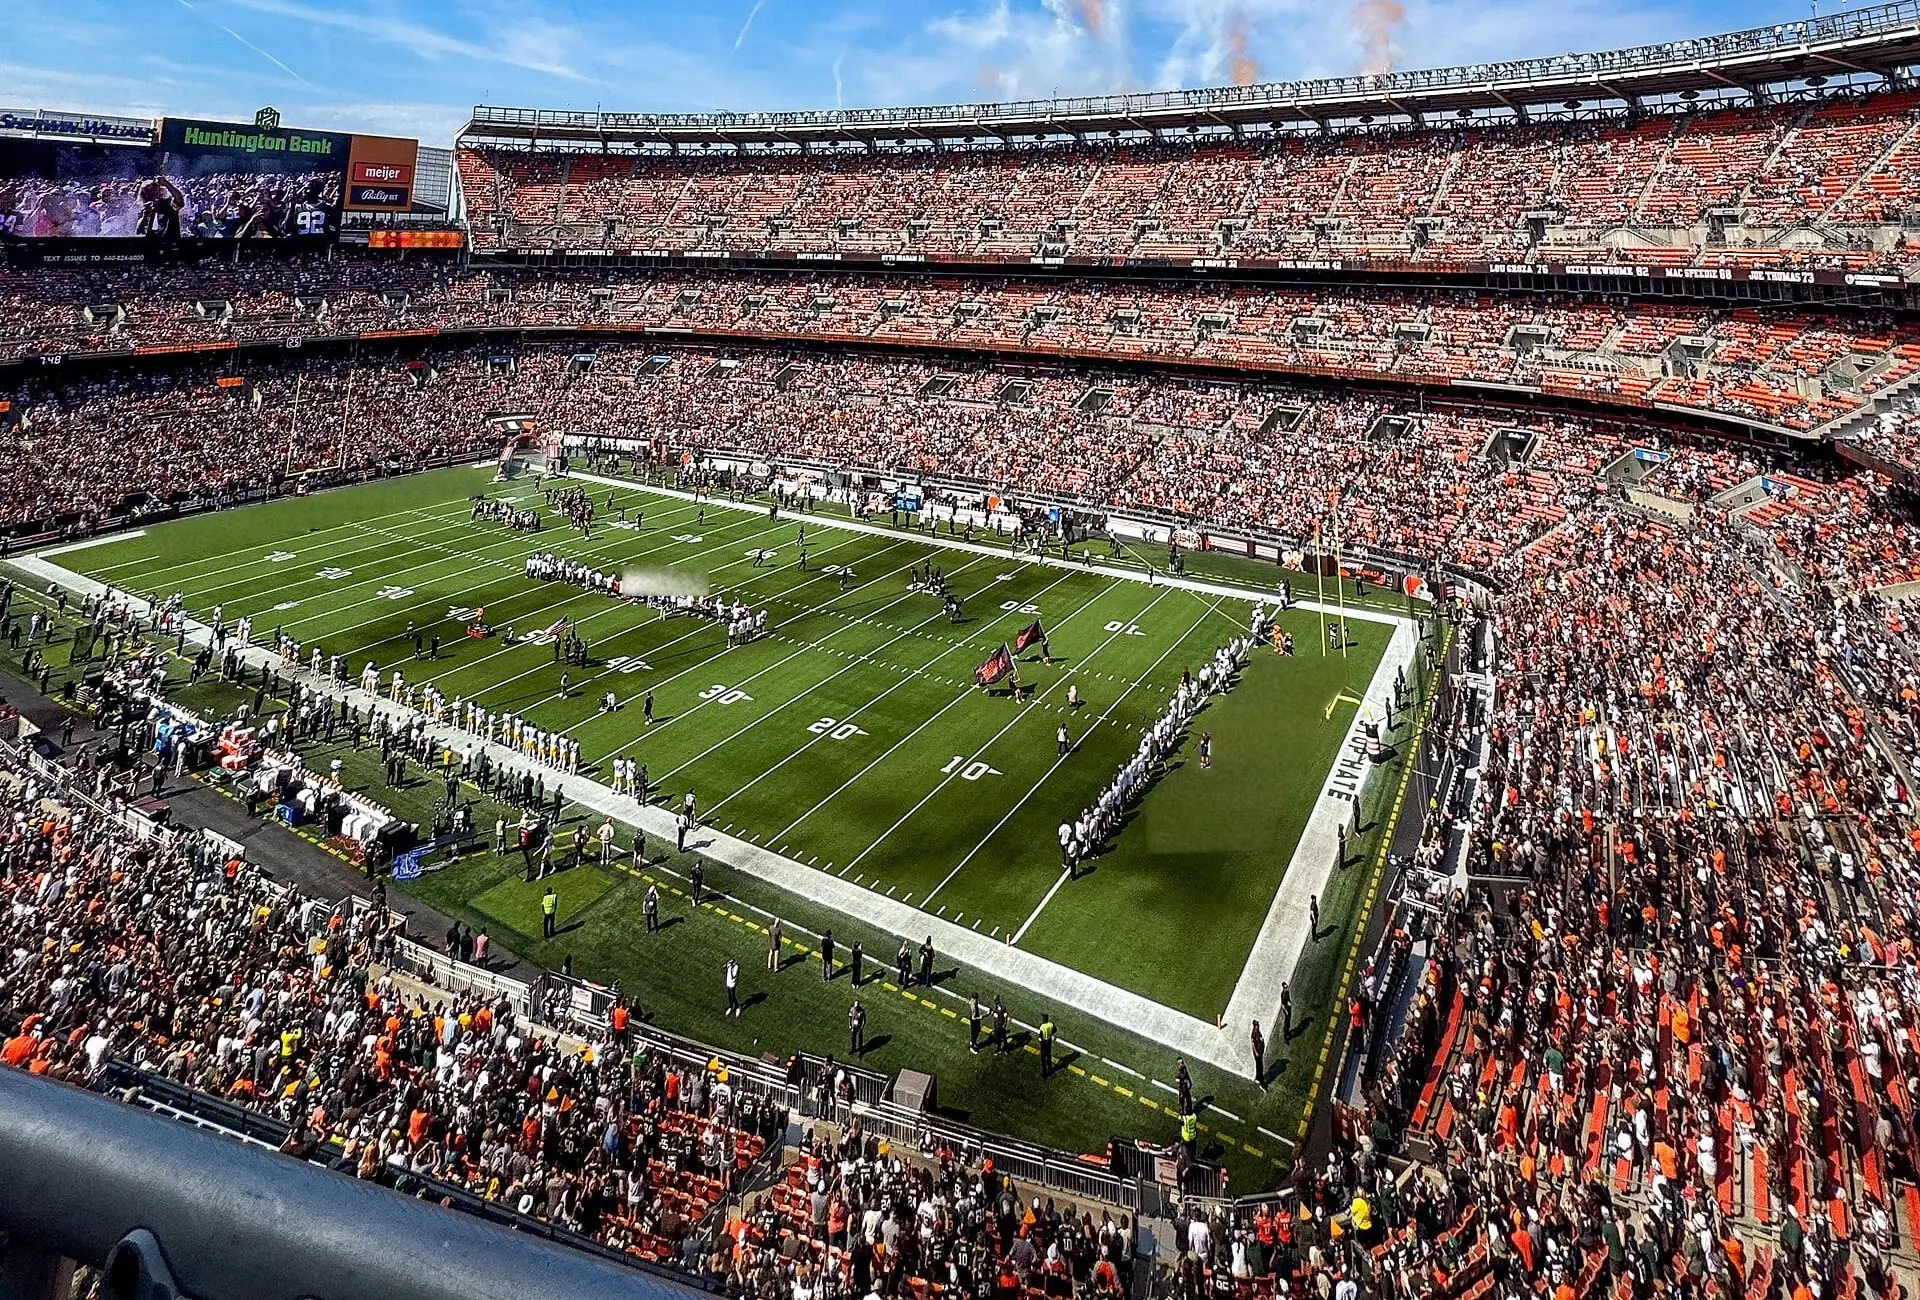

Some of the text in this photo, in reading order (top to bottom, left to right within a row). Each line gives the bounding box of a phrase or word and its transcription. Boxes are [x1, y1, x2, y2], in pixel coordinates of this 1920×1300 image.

[184, 127, 332, 154] Huntington Bank
[365, 167, 400, 180] meijer
[361, 190, 388, 202] Bally
[297, 211, 325, 234] 92
[1489, 264, 1548, 274] LOU GROZA 76
[1590, 266, 1633, 276] NEWSOME
[1665, 268, 1684, 277] MAC
[1749, 271, 1814, 283] JOE THOMAS 73
[699, 685, 746, 704] 30
[806, 717, 859, 740] 20
[940, 755, 990, 780] 10
[1328, 758, 1363, 802] HATE
[743, 1104, 753, 1115] 87
[1062, 1238, 1072, 1251] 10
[957, 1252, 968, 1267] 10
